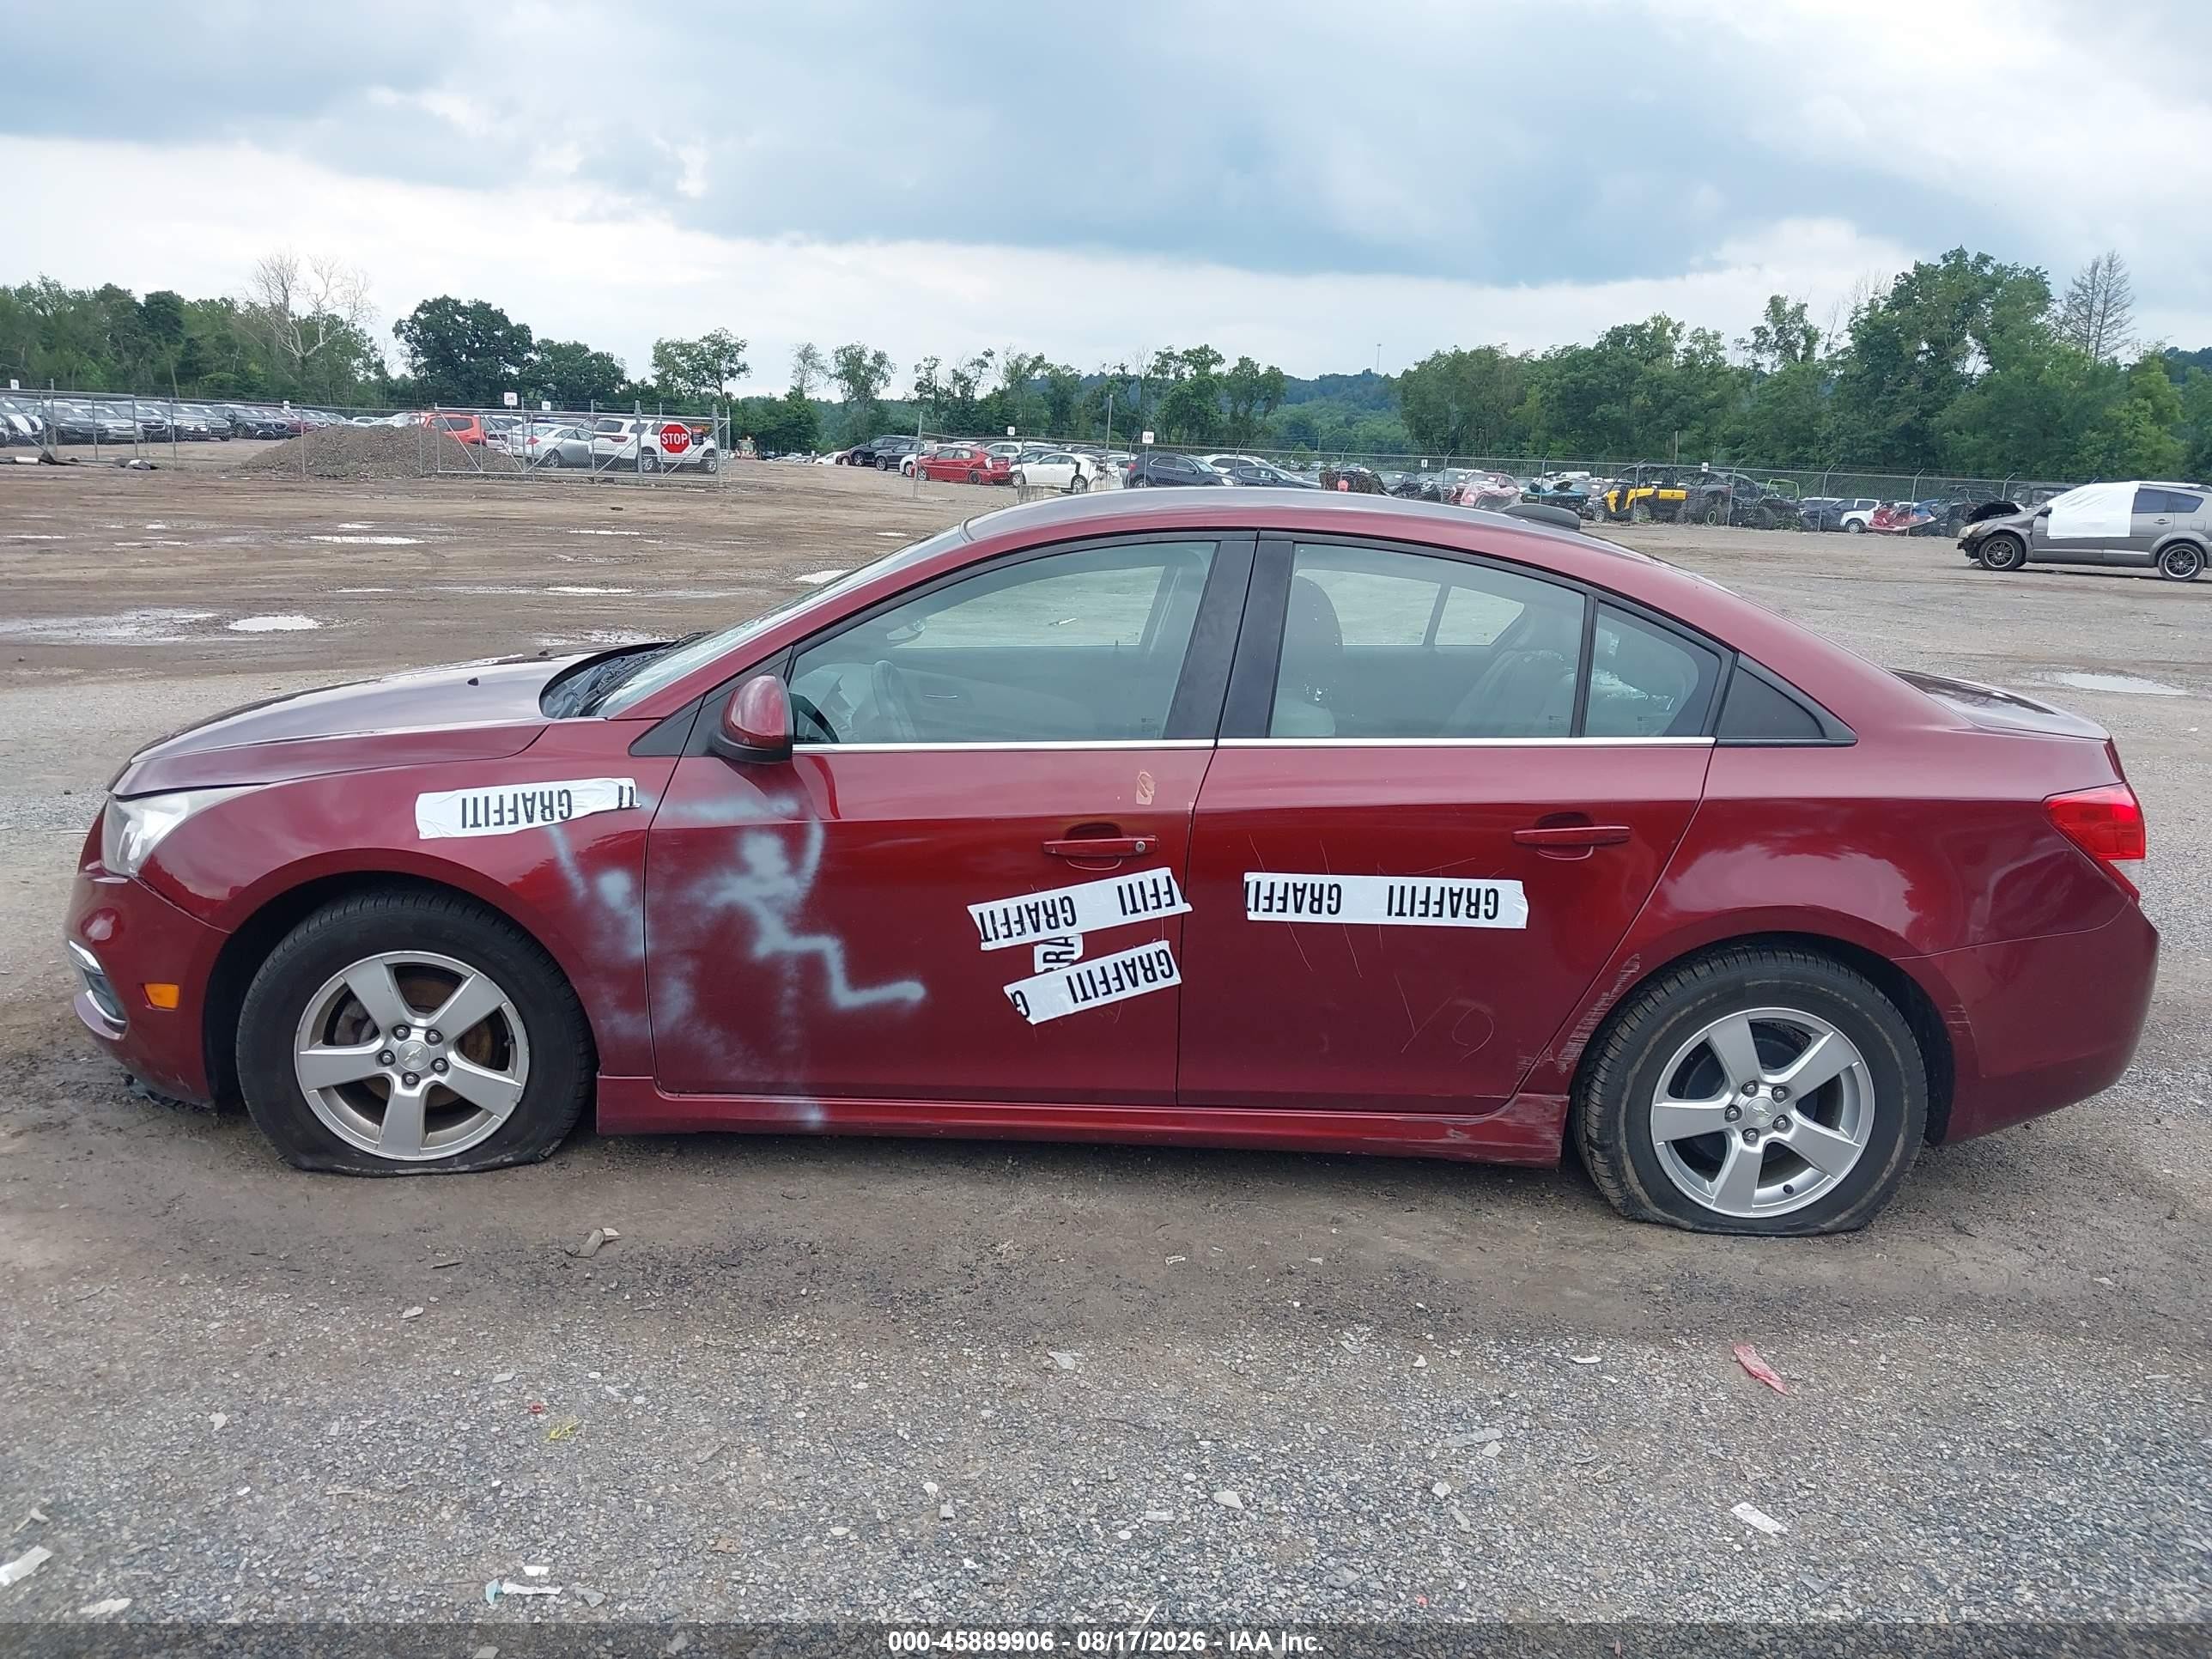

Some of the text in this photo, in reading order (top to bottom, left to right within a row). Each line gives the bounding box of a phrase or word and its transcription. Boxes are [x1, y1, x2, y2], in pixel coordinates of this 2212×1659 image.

[661, 432, 688, 445] STOP
[461, 788, 573, 829] GRAFFITI
[978, 895, 1078, 943] GRAFFIT
[1387, 884, 1499, 921] GRAFFITI
[1066, 949, 1175, 1004] GRAFFITI
